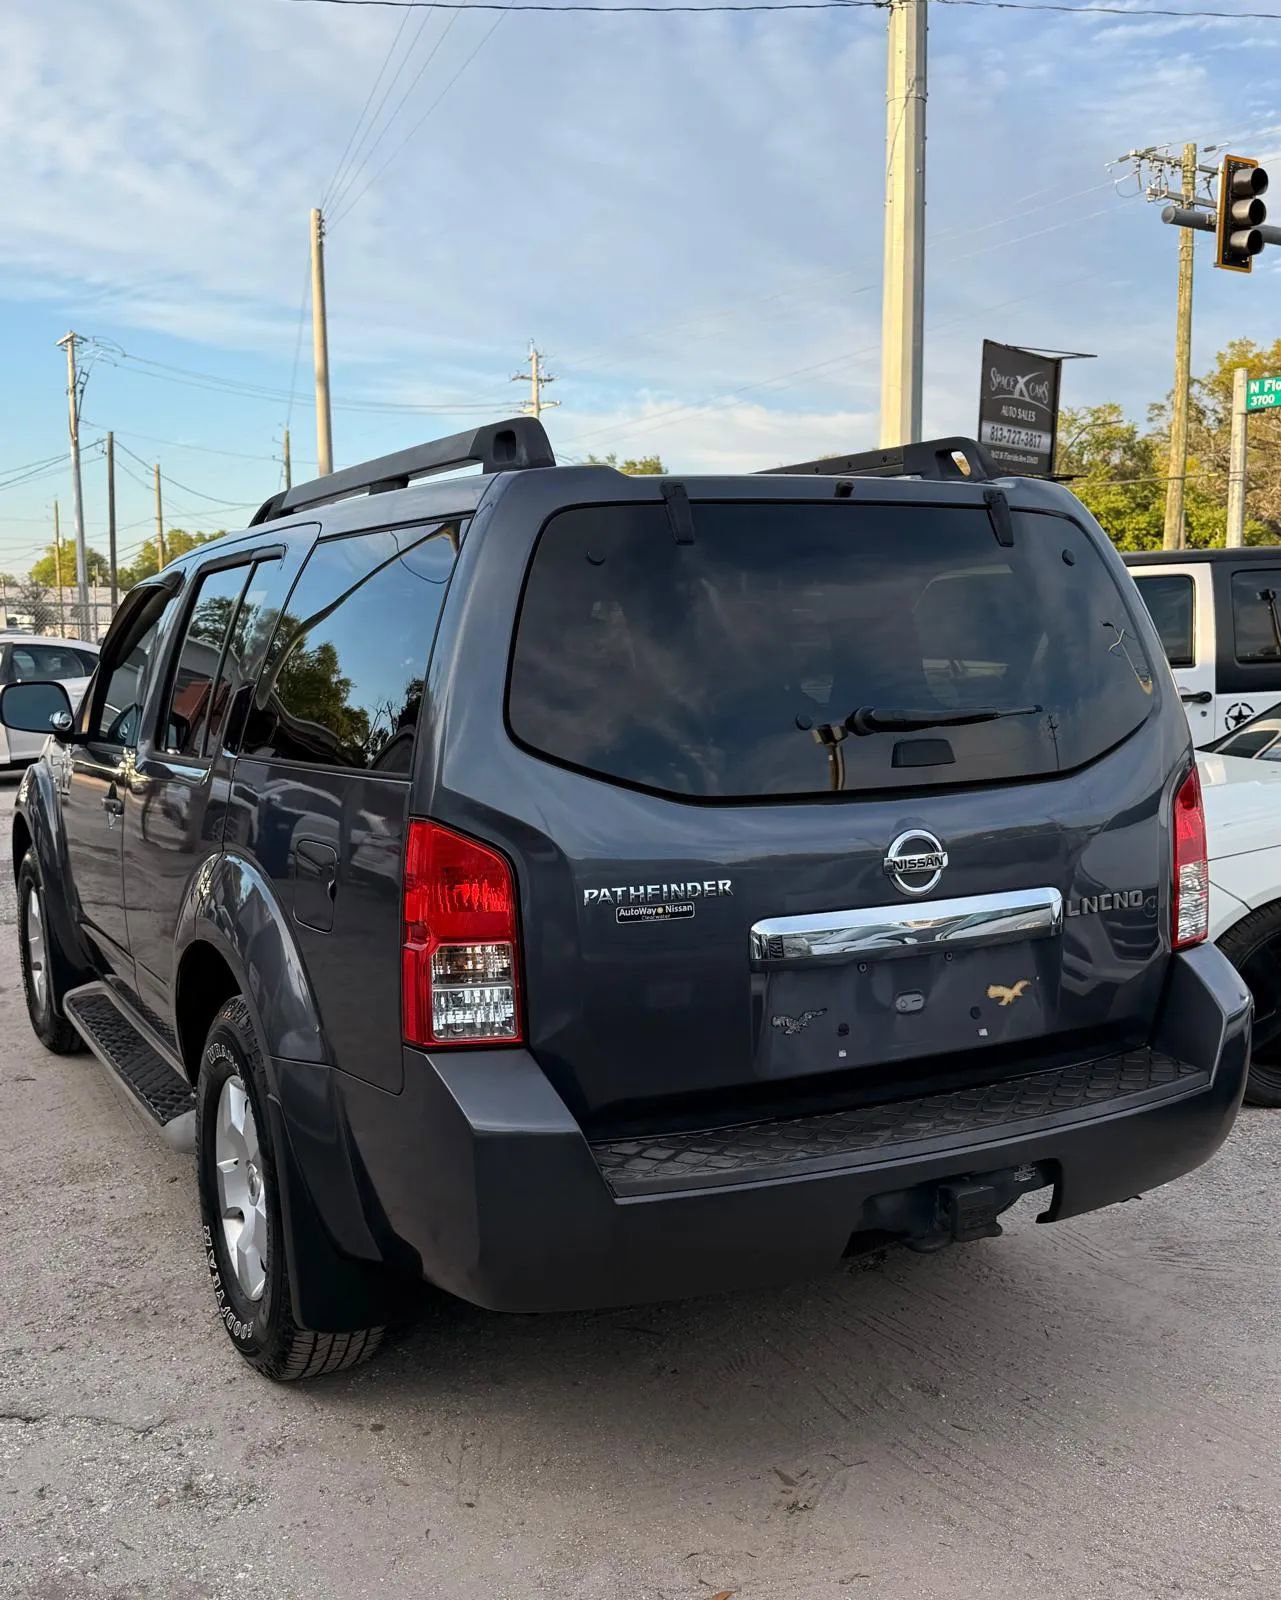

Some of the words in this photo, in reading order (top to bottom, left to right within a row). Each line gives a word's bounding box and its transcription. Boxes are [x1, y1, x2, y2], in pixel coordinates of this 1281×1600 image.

[1250, 381, 1260, 394] N
[1250, 394, 1275, 406] 3700
[1000, 405, 1017, 418] AUTO
[1017, 408, 1036, 422] SALES
[990, 425, 1042, 449] 813-727-3817
[893, 855, 943, 871] NISSAN
[583, 879, 734, 906] PATHFINDER
[619, 907, 657, 917] AutoWay
[665, 904, 693, 914] Nissan
